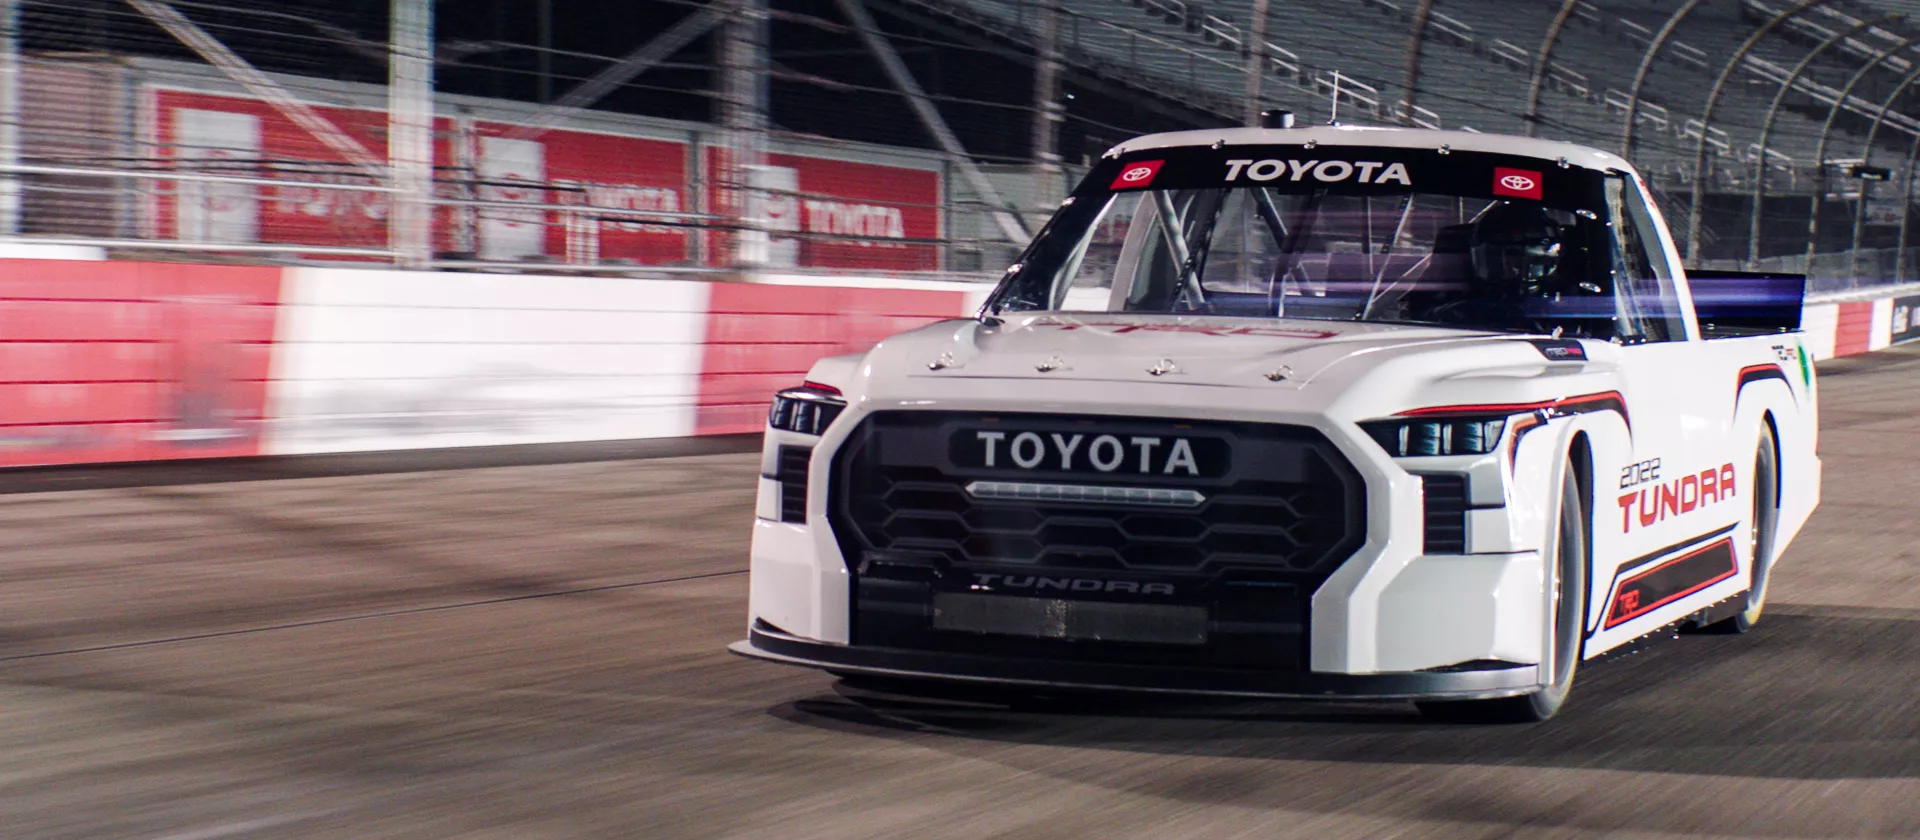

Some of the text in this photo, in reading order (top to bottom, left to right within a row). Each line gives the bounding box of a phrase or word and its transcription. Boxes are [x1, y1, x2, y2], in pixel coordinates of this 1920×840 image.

[1225, 158, 1412, 187] TOYOTA
[804, 199, 907, 249] TOYOTA
[977, 430, 1200, 475] TOYOTA
[1619, 457, 1662, 490] 2022
[1617, 462, 1737, 533] TUNDRA
[973, 572, 1176, 595] TUNDRA
[1620, 589, 1640, 615] TRD
